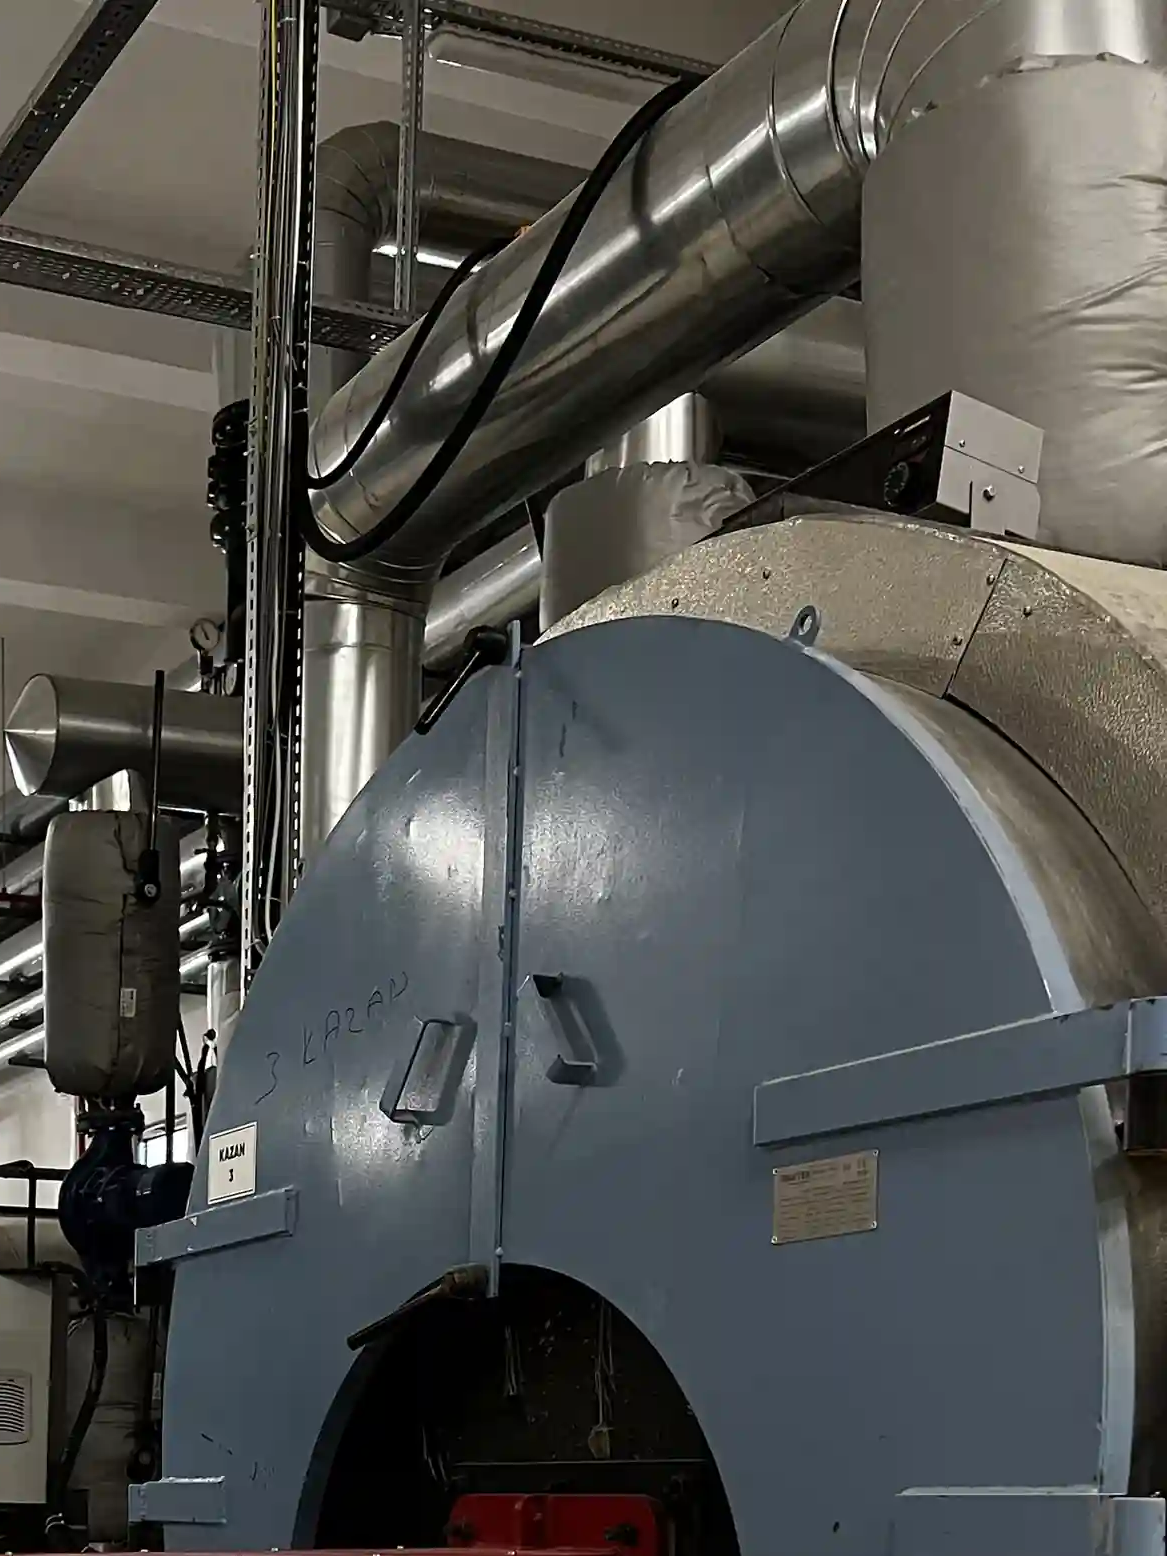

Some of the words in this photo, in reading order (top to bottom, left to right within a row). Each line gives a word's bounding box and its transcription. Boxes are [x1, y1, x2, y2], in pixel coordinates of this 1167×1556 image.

[254, 1051, 281, 1105] 3
[218, 1142, 246, 1162] KAZAN
[228, 1168, 234, 1182] 3
